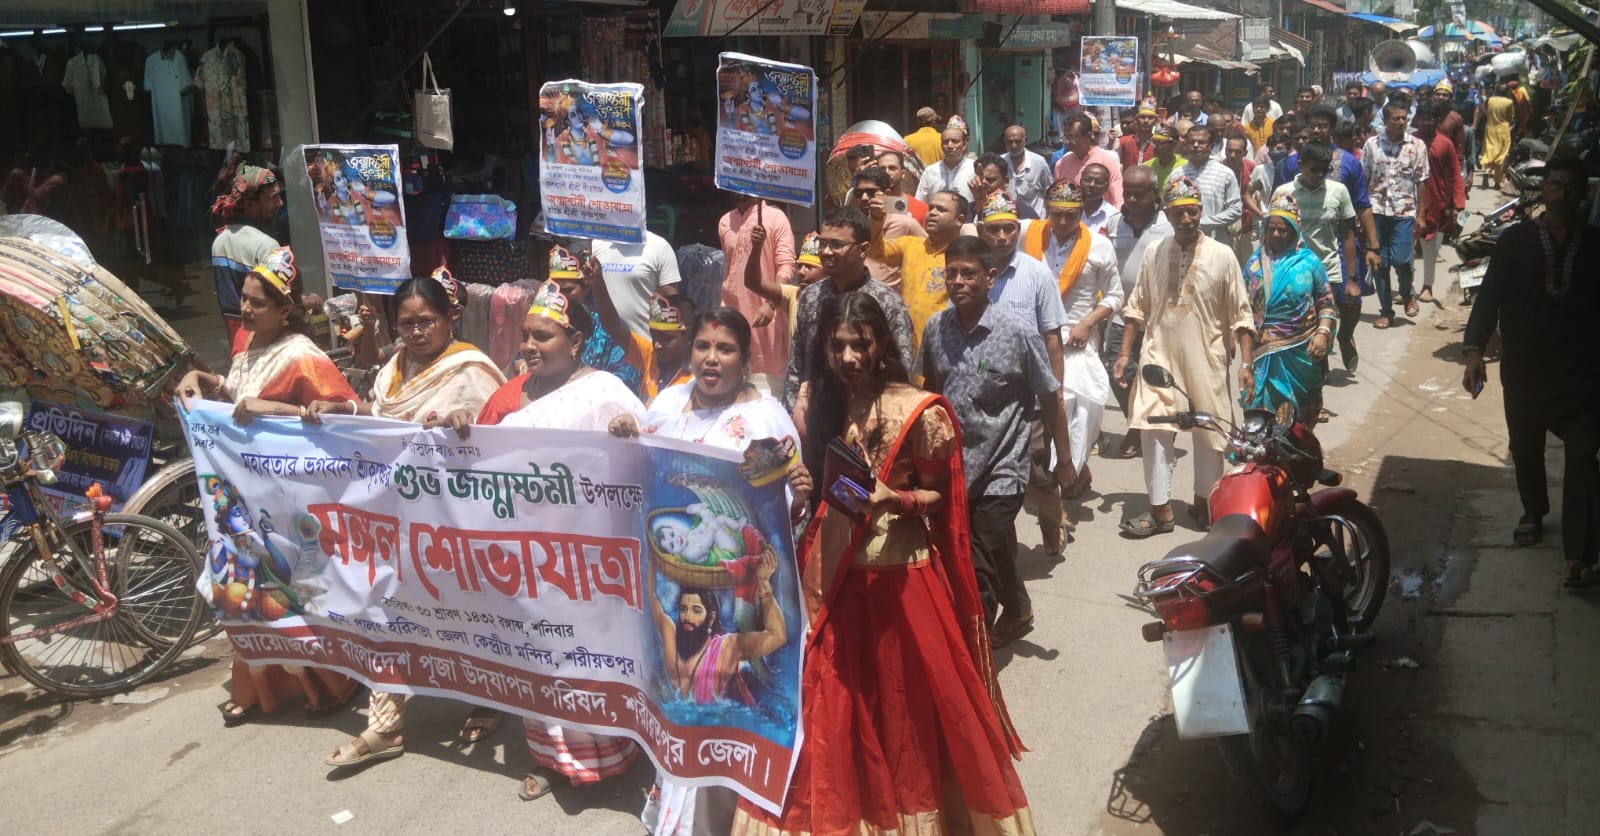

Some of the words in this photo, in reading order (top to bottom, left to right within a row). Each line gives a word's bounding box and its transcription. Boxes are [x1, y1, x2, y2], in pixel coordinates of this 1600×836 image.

[763, 162, 808, 178] শোভাযাত্রা
[546, 194, 587, 209] জন্মাষ্টমী
[588, 199, 633, 214] শোভাযাত্রা
[32, 408, 99, 446] প্রতিদিন
[240, 452, 299, 478] মহাবতার
[303, 455, 352, 478] ভগবান
[394, 463, 440, 500] শুভ
[580, 474, 643, 513] উপলক্ষে
[308, 503, 403, 588] মঙ্গল
[409, 522, 644, 614] শোভাযাত্রা
[386, 616, 435, 641] হরিসভা
[437, 629, 470, 645] জেলা
[474, 633, 513, 657] কেন্দ্রীয়
[514, 642, 560, 669] মন্দির,
[563, 646, 636, 675] শরীয়তপুর
[433, 607, 461, 622] শ্রাবণ
[465, 611, 497, 628] ১৪৩২
[531, 619, 574, 638] শনিবার
[336, 637, 412, 676] বাংলাদেশ
[419, 654, 457, 685] পূজা
[542, 679, 618, 722] পরিষদ,
[621, 690, 686, 770] শরীয়তপুর
[697, 738, 758, 778] জেলা
